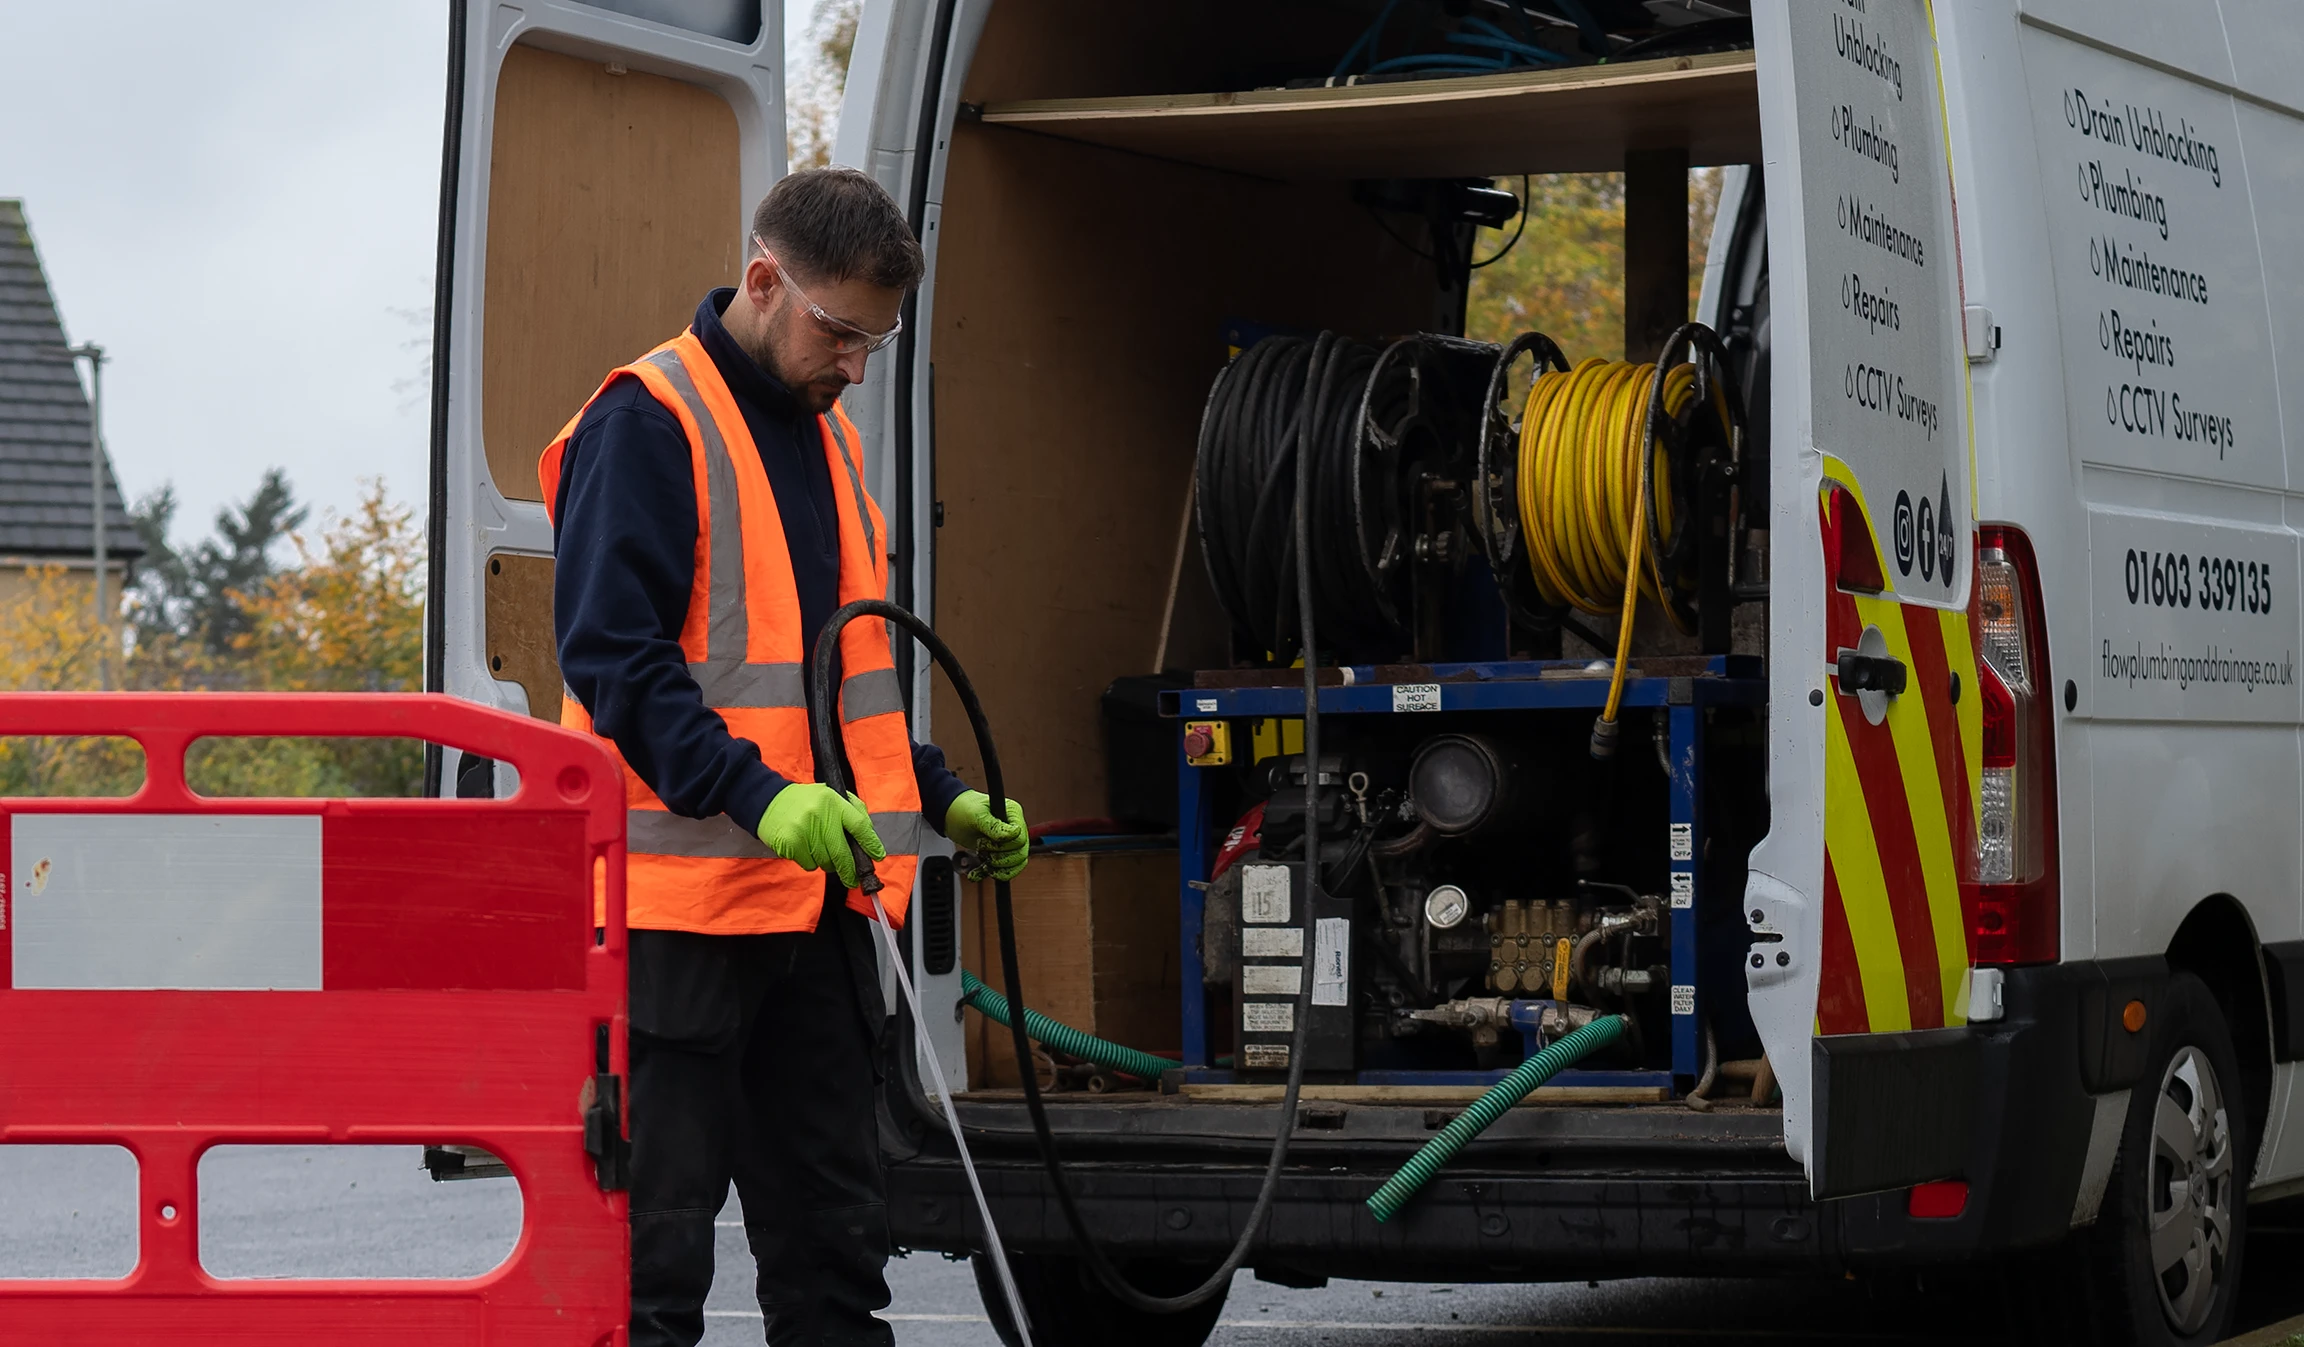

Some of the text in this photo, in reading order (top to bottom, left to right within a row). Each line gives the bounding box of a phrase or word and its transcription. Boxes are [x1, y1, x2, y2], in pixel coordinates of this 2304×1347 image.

[1833, 13, 1903, 102] Unblocking
[1841, 105, 1899, 184] Plumbing
[2075, 89, 2221, 188] Drain Unblocking
[1849, 195, 1924, 267] Maintenance
[2089, 162, 2169, 240] Plumbing
[1852, 274, 1900, 334] Repairs
[2103, 238, 2208, 305] Maintenance
[2111, 309, 2174, 376] Repairs
[1856, 364, 1938, 442] CCTV Surveys
[2119, 384, 2234, 460] CCTV Surveys
[2125, 548, 2272, 615] 01603 339135
[1396, 685, 1438, 694] CAUTION
[1407, 694, 1426, 702] HOT
[2102, 639, 2294, 693] flowplumbinganddrainage.co.uk
[1396, 703, 1438, 711] SURFACE
